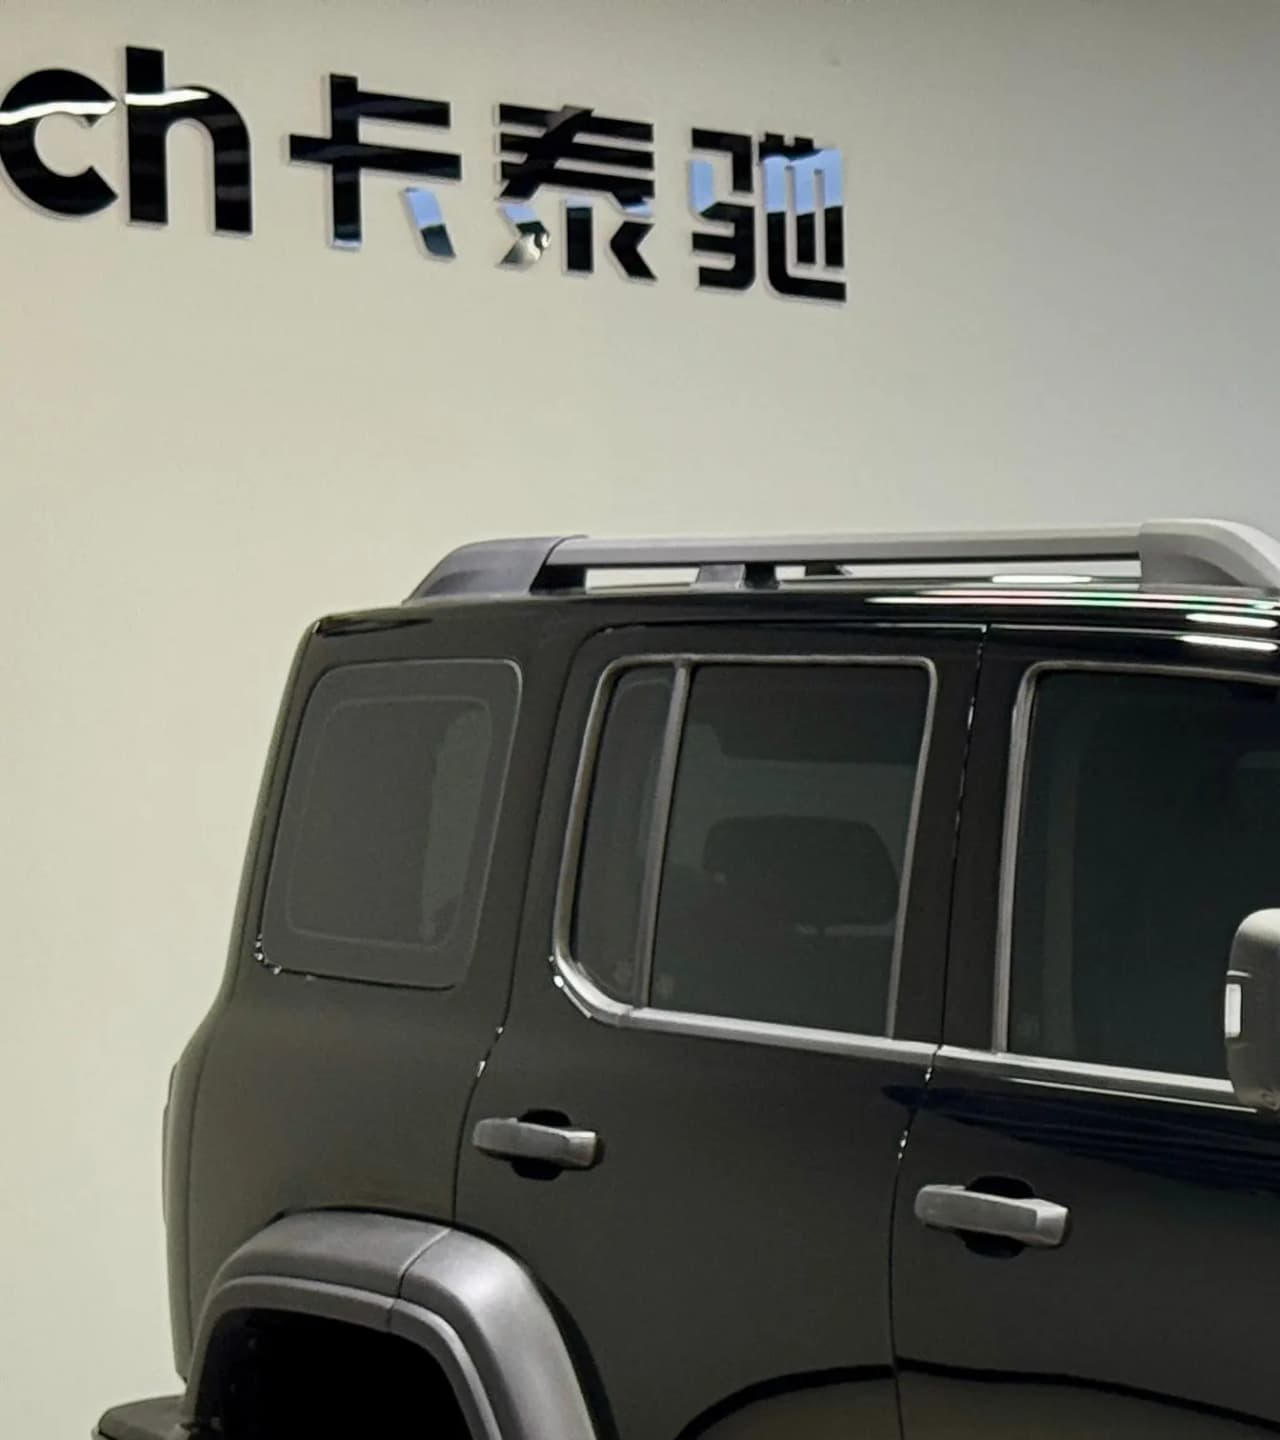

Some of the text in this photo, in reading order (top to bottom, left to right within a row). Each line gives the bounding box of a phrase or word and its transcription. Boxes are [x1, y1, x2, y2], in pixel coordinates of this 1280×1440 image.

[0, 45, 848, 304] ch 卡泰驰
